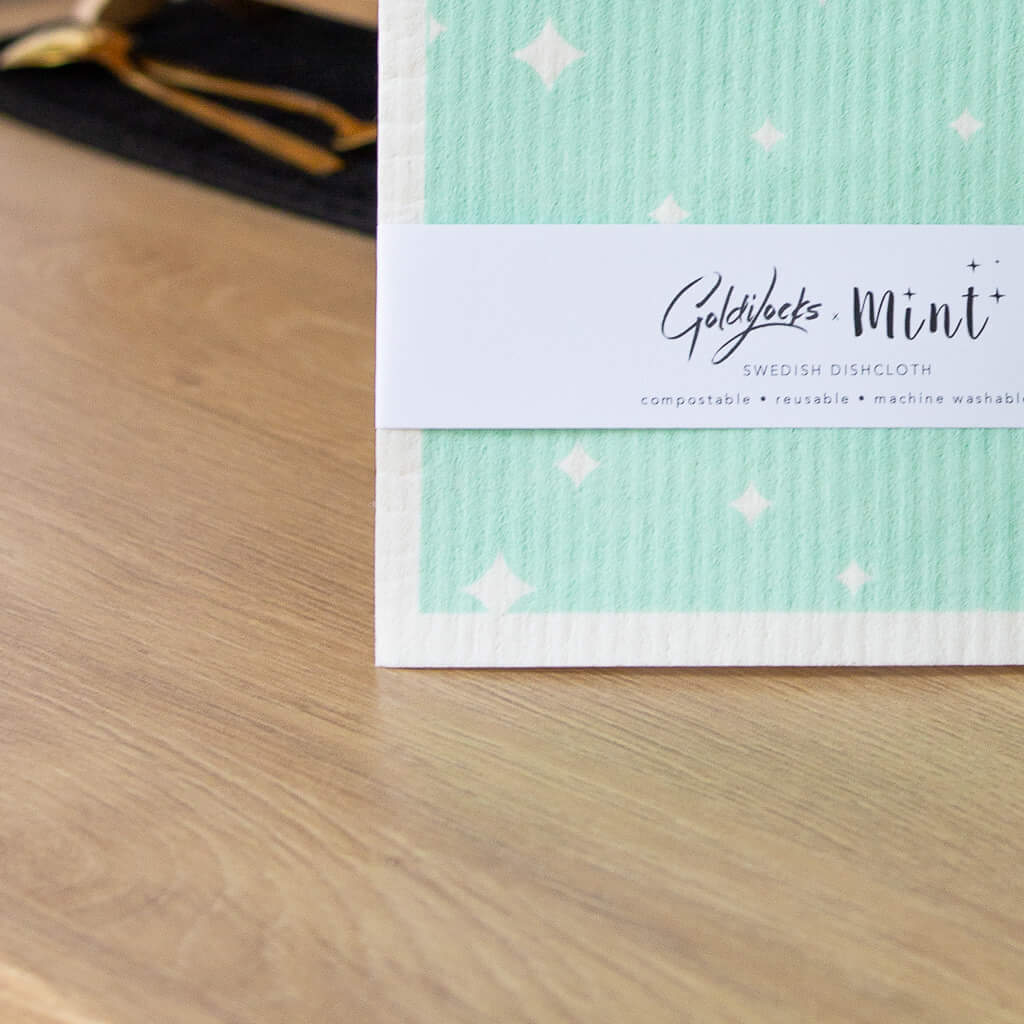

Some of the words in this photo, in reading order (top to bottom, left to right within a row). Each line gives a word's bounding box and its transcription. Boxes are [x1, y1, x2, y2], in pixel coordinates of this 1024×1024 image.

[853, 286, 990, 340] Mint
[743, 364, 822, 377] SWEDISH
[830, 363, 932, 376] DISHCLOTH
[640, 393, 751, 408] compostable
[775, 393, 849, 405] reusable
[874, 392, 944, 404] machine
